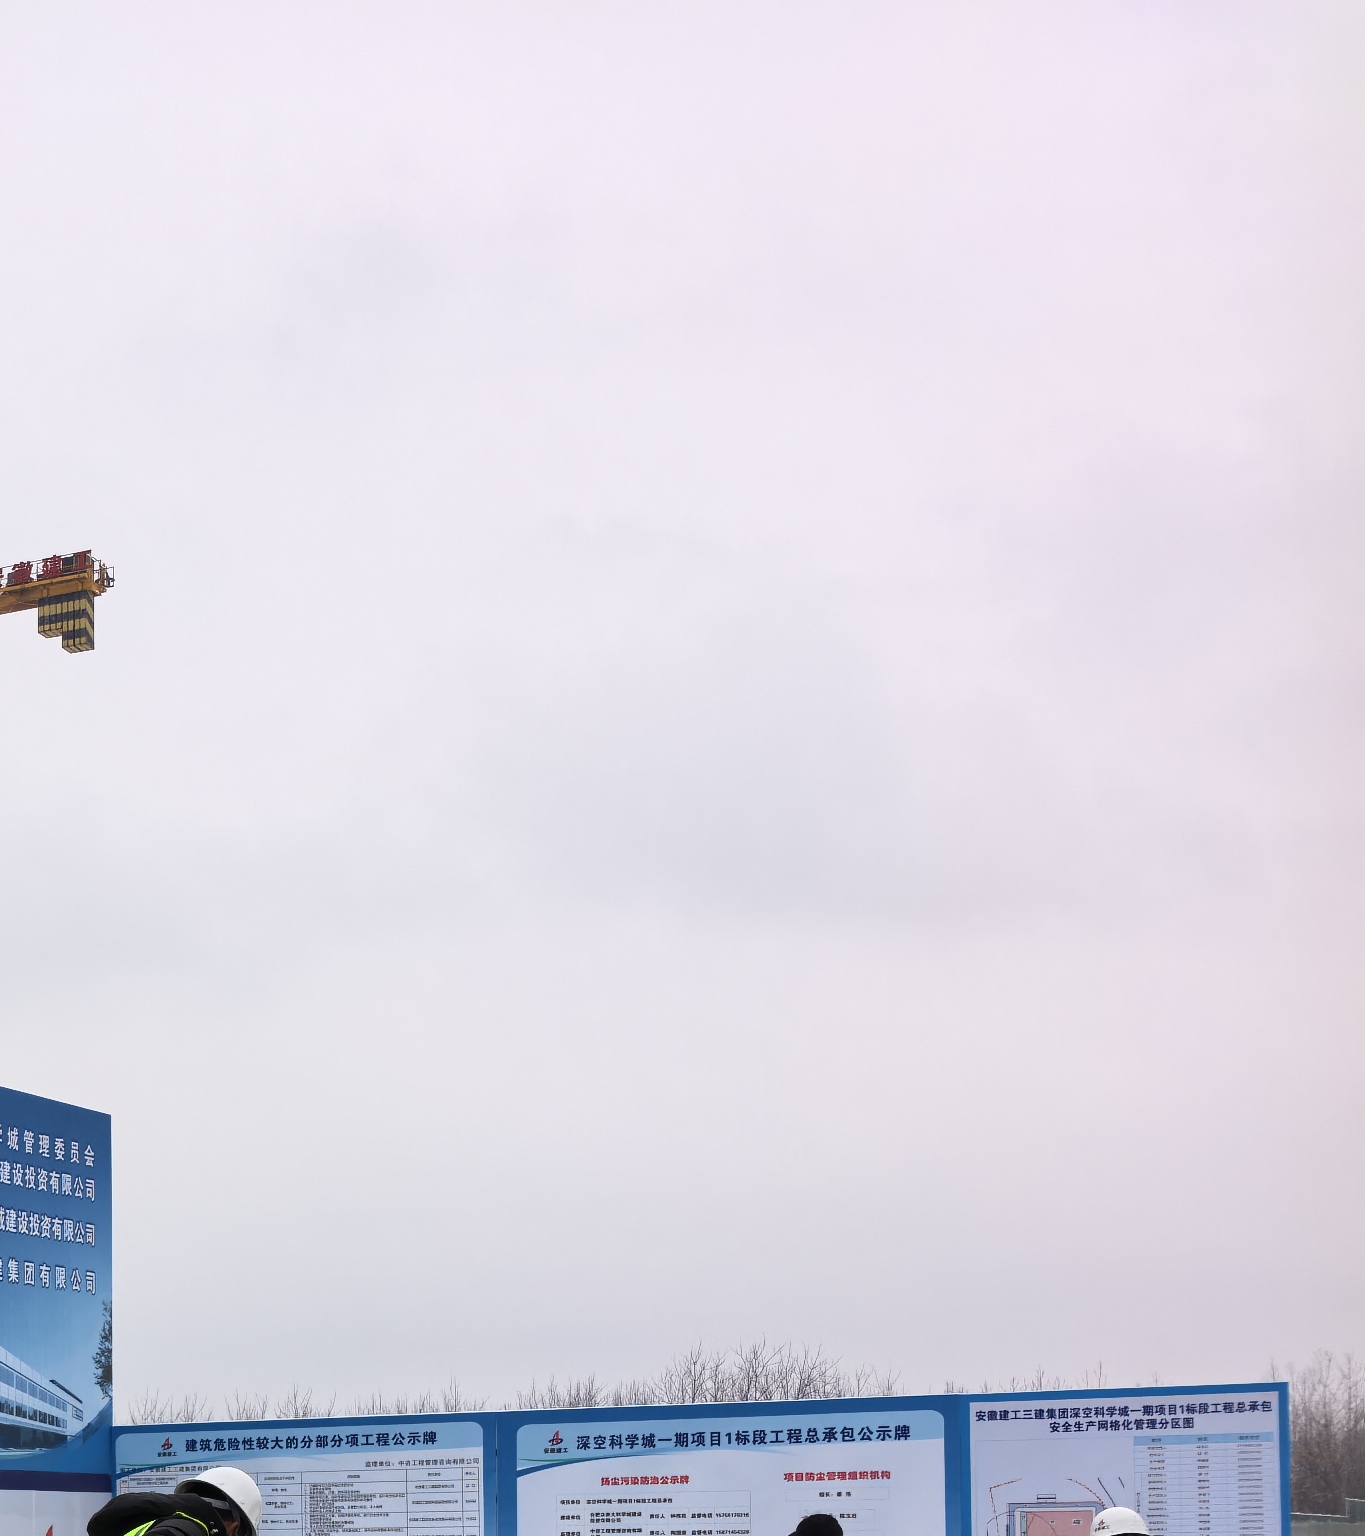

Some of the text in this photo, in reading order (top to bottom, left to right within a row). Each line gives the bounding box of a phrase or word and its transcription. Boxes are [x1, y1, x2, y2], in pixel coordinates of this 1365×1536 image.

[975, 1400, 1273, 1422] 安徽建工三建集团深空科学城一期项目1标段工程总承包
[1049, 1417, 1195, 1433] 安全生产网格化管理分区图
[184, 1431, 438, 1453] 建筑危险性较大的分部分项工程公示牌
[575, 1424, 912, 1451] 深空科学城一期项目1标段工程总承包公示牌
[600, 1475, 690, 1487] 扬尘污染防治公示牌
[783, 1471, 891, 1483] 项目防尘管理组织机构
